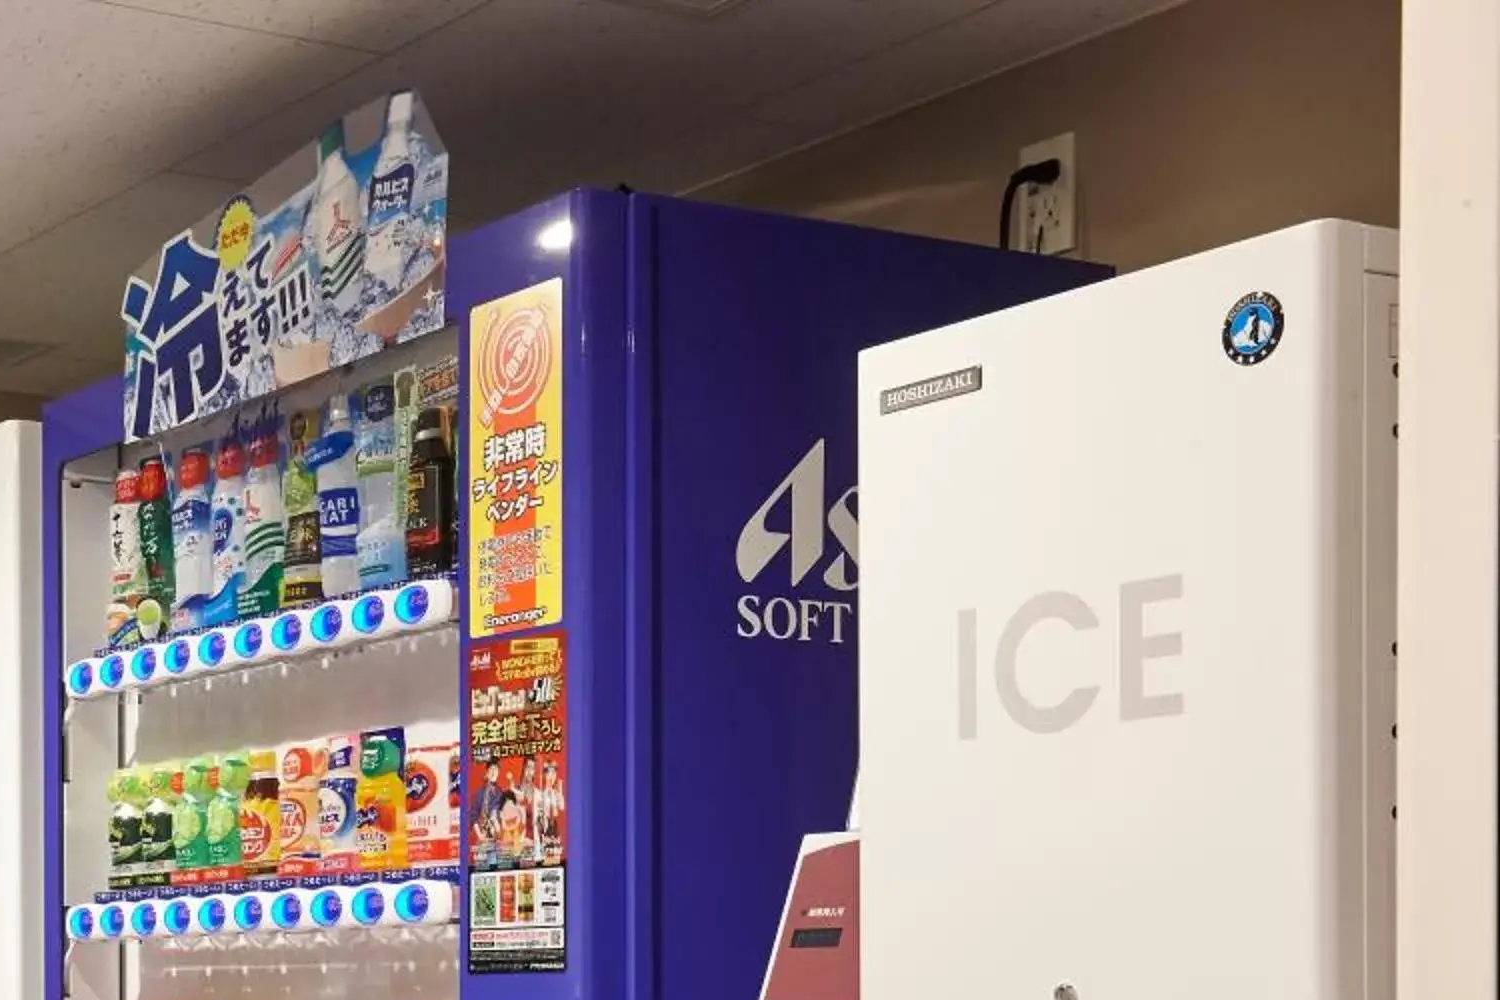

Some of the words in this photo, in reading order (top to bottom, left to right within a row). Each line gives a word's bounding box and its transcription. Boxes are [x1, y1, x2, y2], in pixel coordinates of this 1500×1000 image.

[122, 232, 222, 439] 冷
[886, 371, 974, 409] HOSHIZAKI
[484, 424, 547, 470] 非常時
[473, 460, 558, 501] ライフライン
[486, 494, 544, 521] ベンダー
[737, 595, 852, 643] SOFT
[957, 573, 1185, 741] ICE
